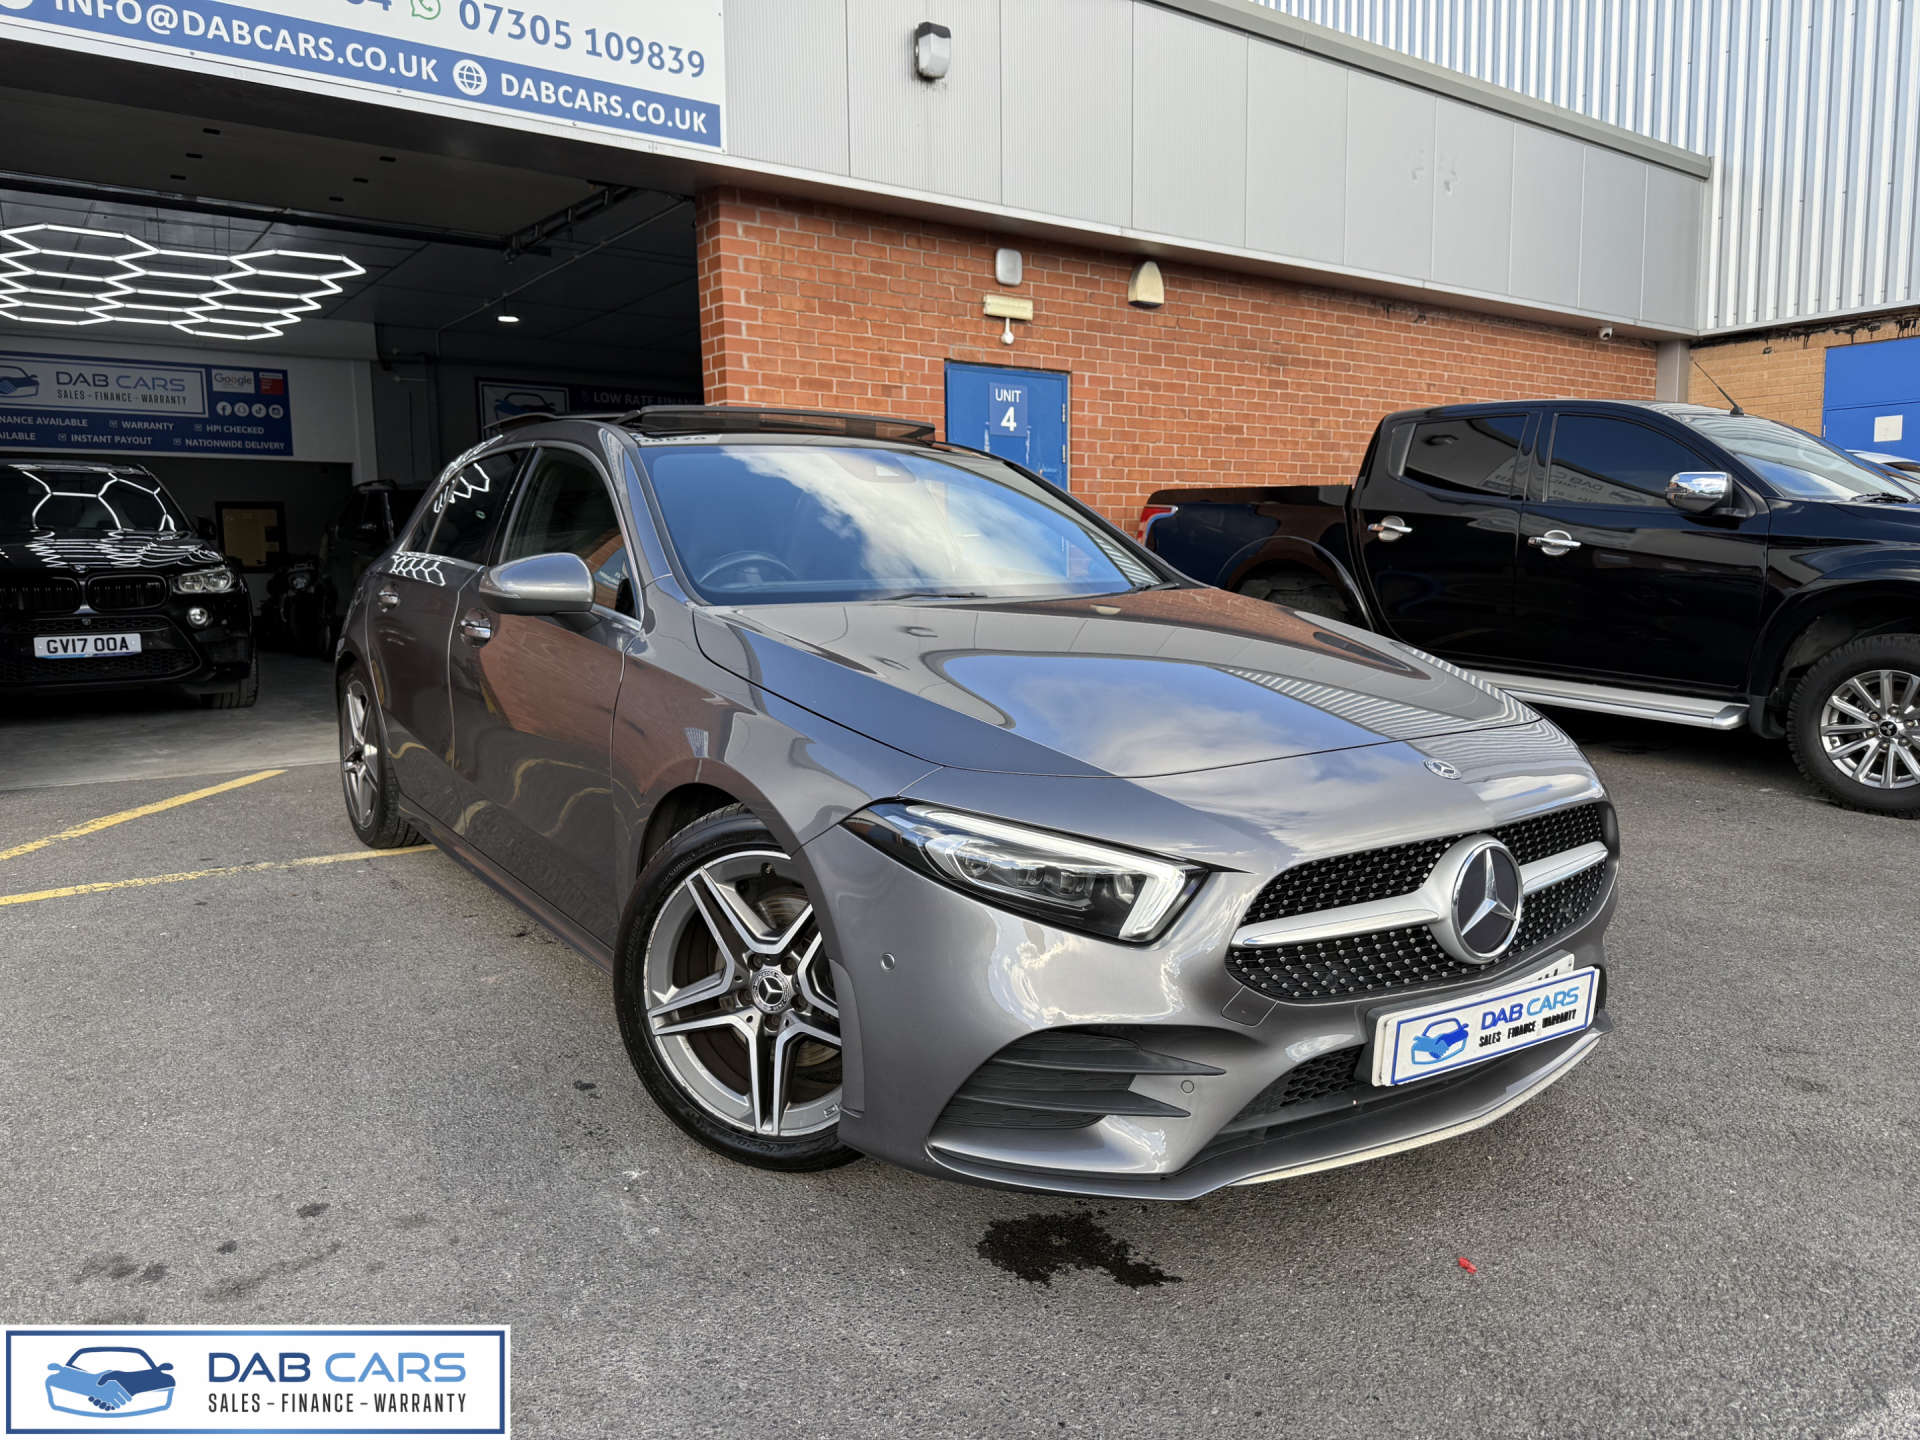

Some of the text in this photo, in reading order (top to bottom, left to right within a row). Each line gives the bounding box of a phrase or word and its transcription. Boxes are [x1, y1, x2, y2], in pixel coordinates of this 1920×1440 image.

[459, 0, 705, 79] 07305 109839
[501, 73, 707, 134] DABCARS.CO.UK
[56, 371, 186, 392] DAB CARS
[214, 373, 252, 386] Google
[57, 389, 85, 400] SALES
[95, 391, 132, 402] FINANCE
[141, 393, 187, 406] WARRANTY
[593, 391, 622, 404] LOW
[995, 388, 1022, 403] UNIT
[36, 416, 88, 427] AVAILABLE
[121, 420, 174, 431] WARRANTY
[206, 424, 221, 433] HPI
[224, 425, 264, 435] CHECKED
[1000, 406, 1017, 432] 4
[71, 434, 112, 444] INSTANT
[115, 435, 152, 445] PAYOUT
[185, 438, 241, 449] NATIONWIDE
[246, 440, 285, 450] DELIVERY
[46, 638, 88, 654] GV17
[1481, 987, 1579, 1030] DAB CARS
[1479, 1009, 1577, 1048] SALES FINANCE WARRANTY
